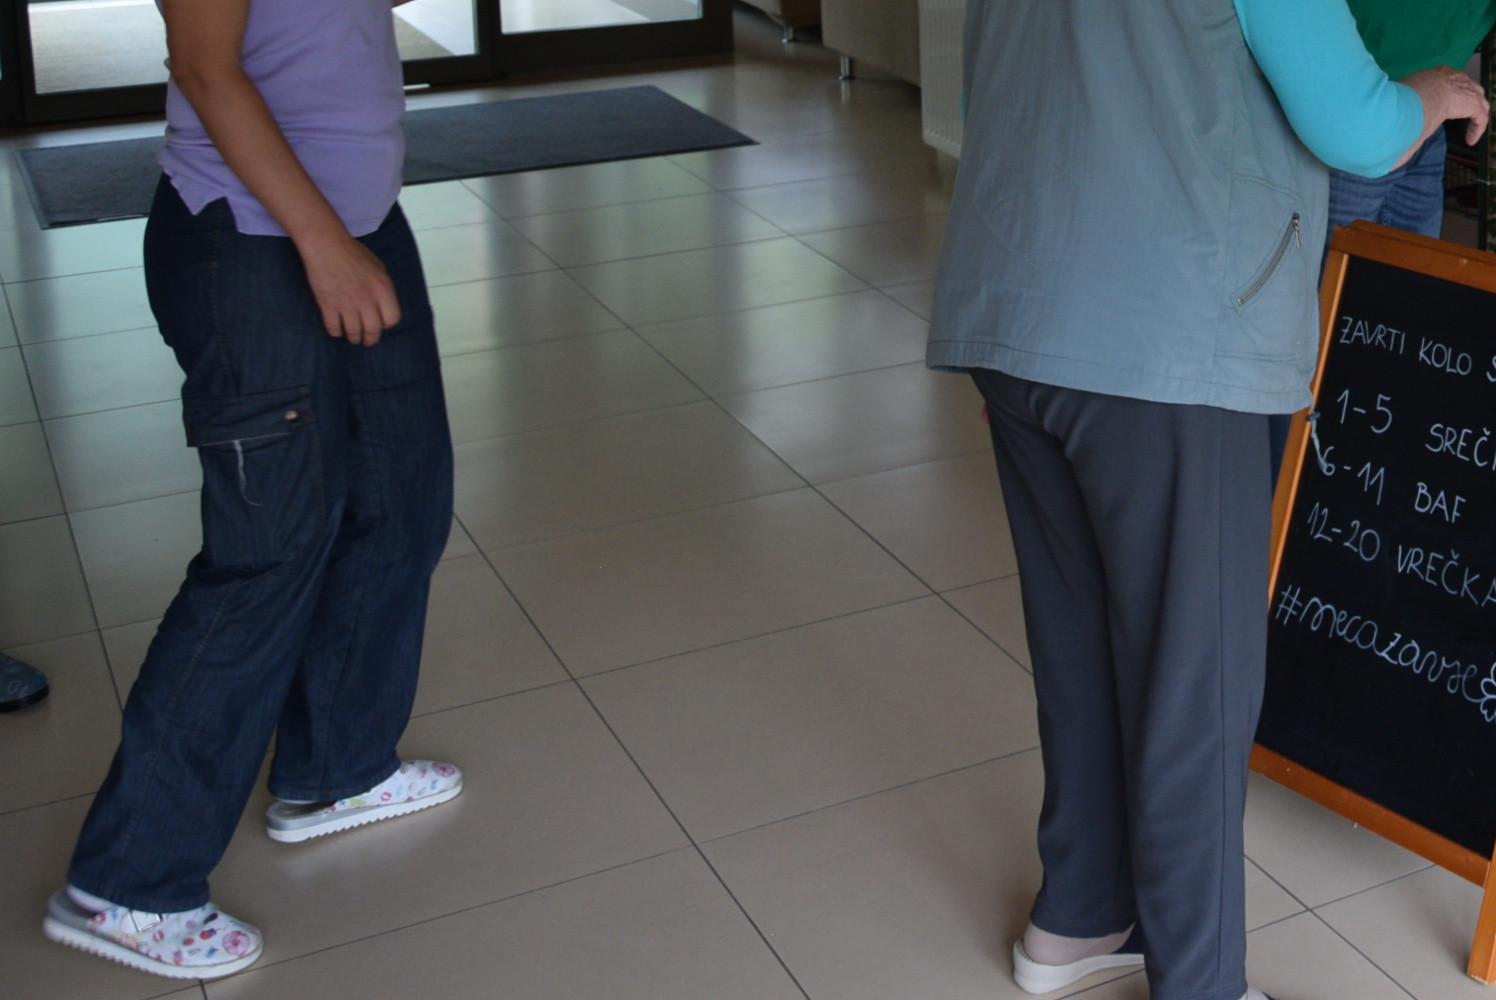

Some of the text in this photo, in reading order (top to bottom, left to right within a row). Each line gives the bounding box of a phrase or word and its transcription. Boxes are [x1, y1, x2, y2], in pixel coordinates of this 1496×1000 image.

[1340, 316, 1406, 354] ZAVRTI
[1418, 336, 1473, 376] KOLO
[1307, 502, 1381, 562] 12-20
[1414, 481, 1467, 524] BAF
